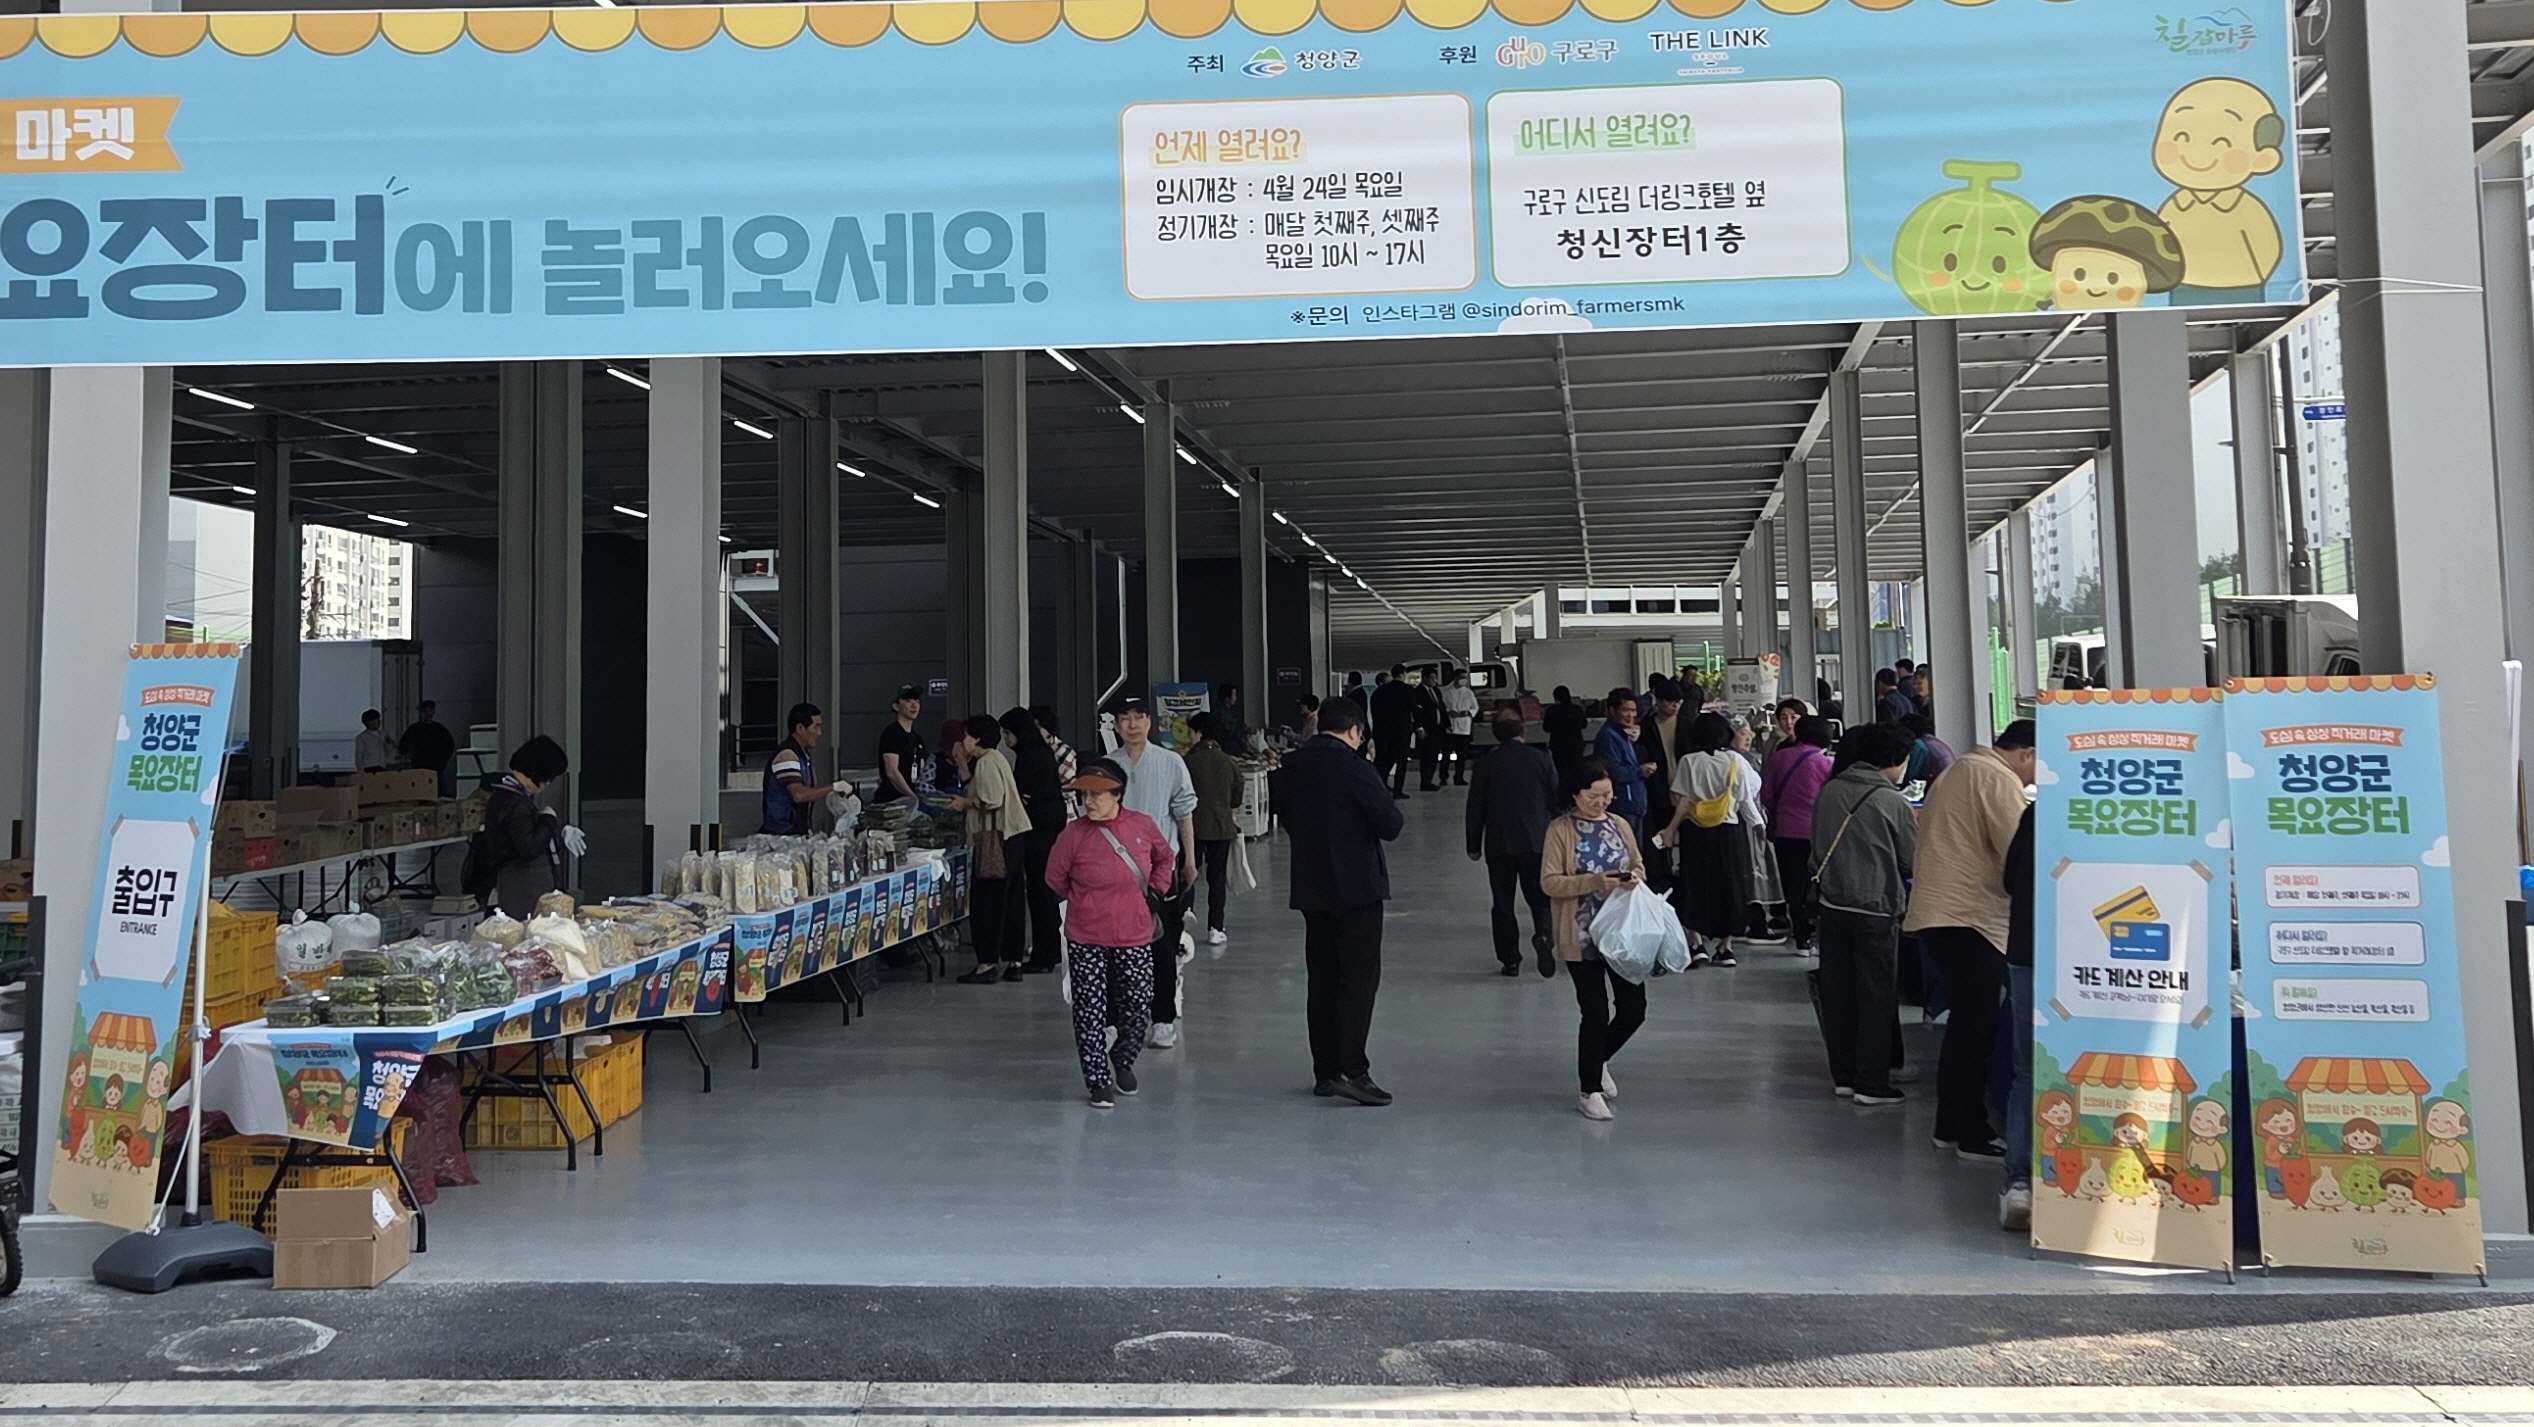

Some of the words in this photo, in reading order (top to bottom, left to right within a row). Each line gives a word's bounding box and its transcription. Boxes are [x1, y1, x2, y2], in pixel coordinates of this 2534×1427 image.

[1438, 45, 1477, 64] 후원
[1552, 41, 1618, 62] 구로구
[1649, 32, 1699, 50] THE
[1708, 29, 1768, 48] LINK
[1186, 54, 1225, 74] 주최
[1295, 50, 1361, 70] 청양군
[16, 107, 134, 161] 마켓
[1154, 130, 1207, 164] 언제
[1217, 127, 1301, 163] 열려요?
[1519, 116, 1596, 151] 어디서
[1605, 112, 1692, 149] 열려요?
[1156, 177, 1238, 204] 임시개장
[1263, 174, 1295, 202] 4월
[1303, 173, 1347, 200] 24일
[1355, 171, 1403, 198] 목요일
[1524, 189, 1567, 216] 구로구
[1576, 186, 1630, 215] 신도림
[1639, 181, 1735, 211] 더링크호텔
[1744, 180, 1766, 208] 옆
[1157, 214, 1239, 241] 정기개장
[1265, 212, 1306, 237] 매달
[1313, 209, 1376, 238] 첫째주,
[1382, 207, 1440, 234] 셋째주
[1556, 222, 1746, 259] 청신장터1층
[0, 194, 512, 320] 요장터에
[540, 209, 1050, 315] 놀러오세요!
[1265, 243, 1313, 269] 목요일
[1321, 241, 1358, 267] 10시
[1385, 239, 1425, 265] 17시
[1362, 304, 1456, 324] 인스타그램
[1461, 296, 1685, 320] @sindorim_farmersmk
[141, 712, 202, 752] 청양군
[2073, 735, 2096, 749] 도심
[2097, 734, 2107, 746] 속
[2108, 733, 2129, 746] 싱싱
[2130, 733, 2164, 746] 직거래
[2165, 735, 2190, 749] 마켓
[2269, 731, 2294, 744] 도심
[2295, 729, 2306, 741] 속
[2307, 728, 2330, 741] 싱싱
[2331, 727, 2367, 740] 직거래
[2369, 729, 2395, 743] 마켓
[127, 754, 203, 793] 목요장터
[2080, 757, 2183, 796] 청양군
[2278, 754, 2392, 793] 청양군
[2067, 798, 2197, 836] 목요장터
[2267, 796, 2410, 835] 목요장터
[112, 866, 178, 917] 출입구
[119, 921, 158, 937] ENTRANCE
[2073, 966, 2101, 986] 카드
[2104, 967, 2144, 988] 계산
[2148, 969, 2189, 991] 안내
